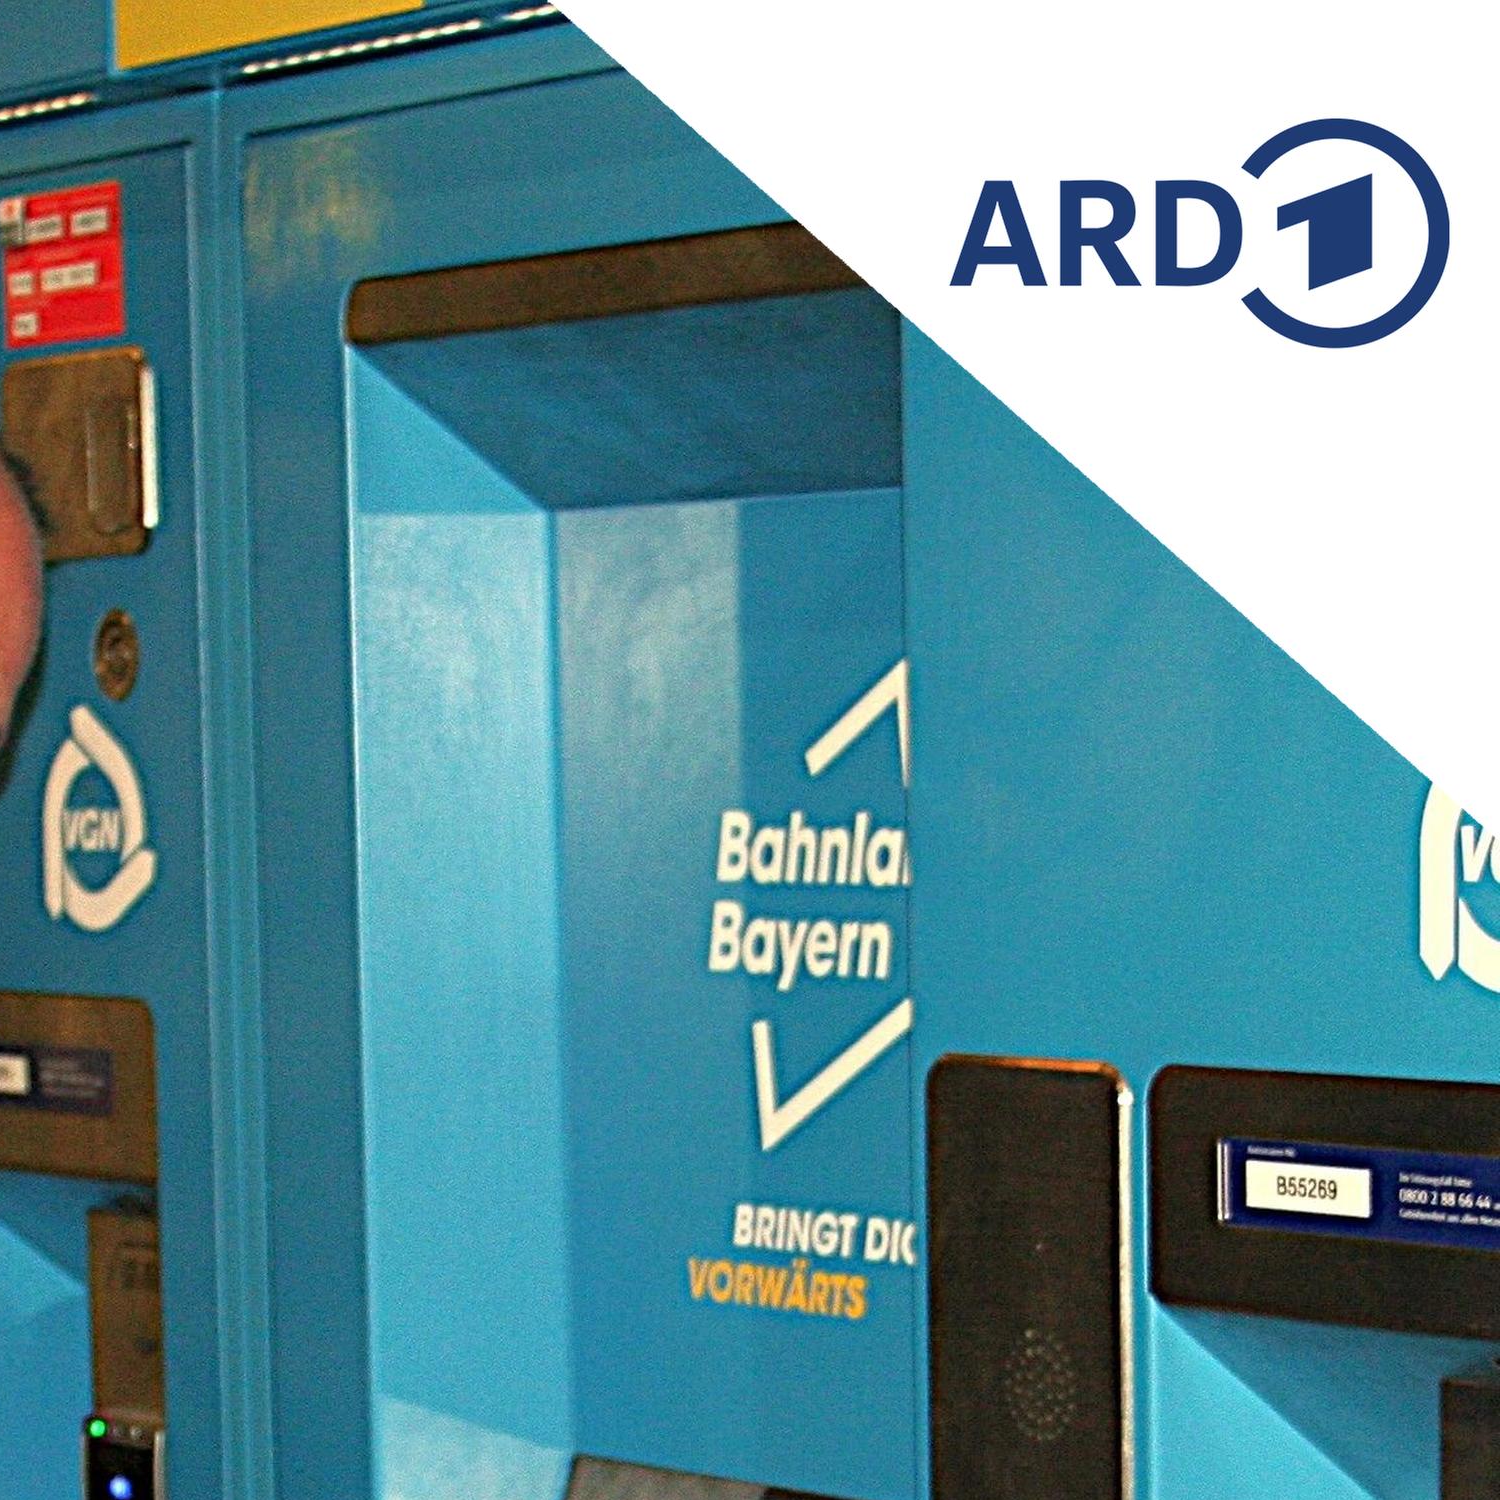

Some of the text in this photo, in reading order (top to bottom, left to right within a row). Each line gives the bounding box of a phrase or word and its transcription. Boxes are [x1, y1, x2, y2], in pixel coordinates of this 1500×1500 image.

[63, 807, 120, 850] VGN
[716, 810, 911, 886] Bahnla
[708, 899, 891, 991] Bayern
[1276, 1175, 1338, 1200] B55269
[733, 1203, 859, 1258] BRINGT
[688, 1254, 868, 1320] VORWÄRTS
